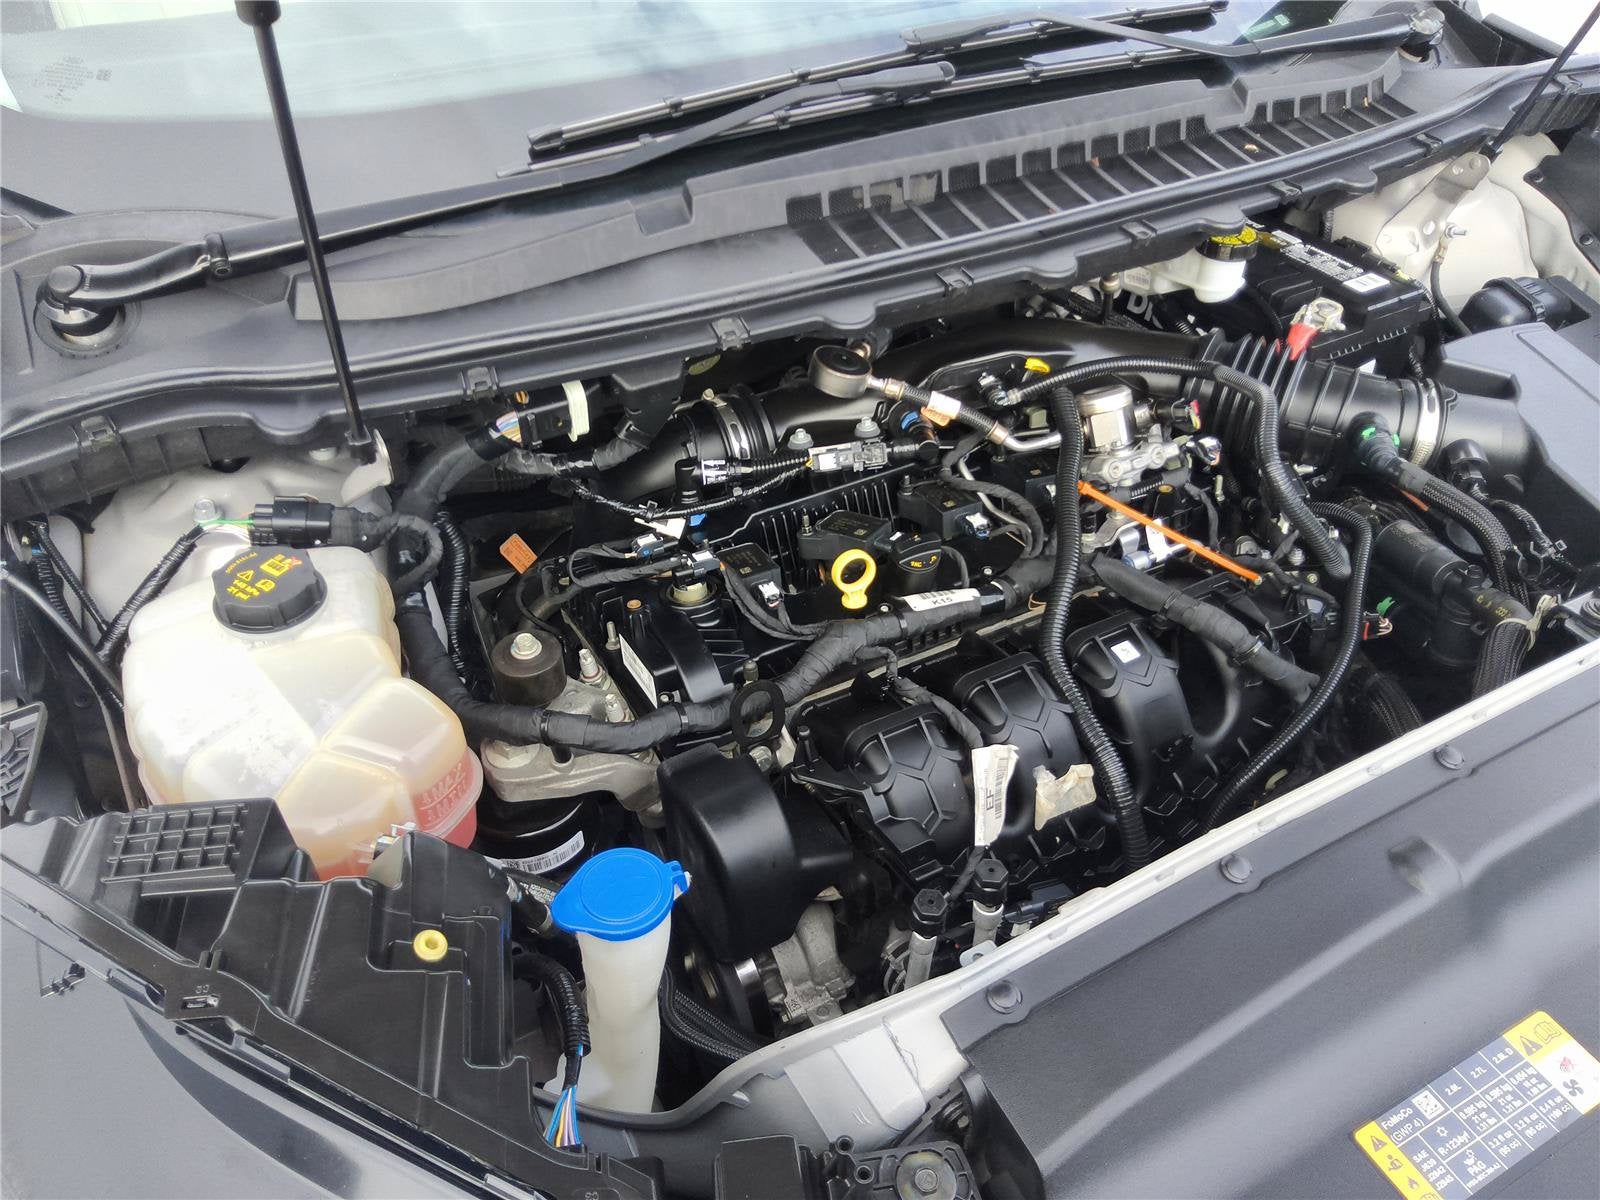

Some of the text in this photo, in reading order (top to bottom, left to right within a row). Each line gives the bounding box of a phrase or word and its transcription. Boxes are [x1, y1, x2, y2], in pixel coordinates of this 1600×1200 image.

[1381, 1107, 1413, 1130] FoMoCo
[1390, 1117, 1425, 1145] (GWP 4)
[1437, 1130, 1471, 1156] R-1234yf
[1412, 1149, 1430, 1163] SAE
[1467, 1160, 1487, 1176] PAG
